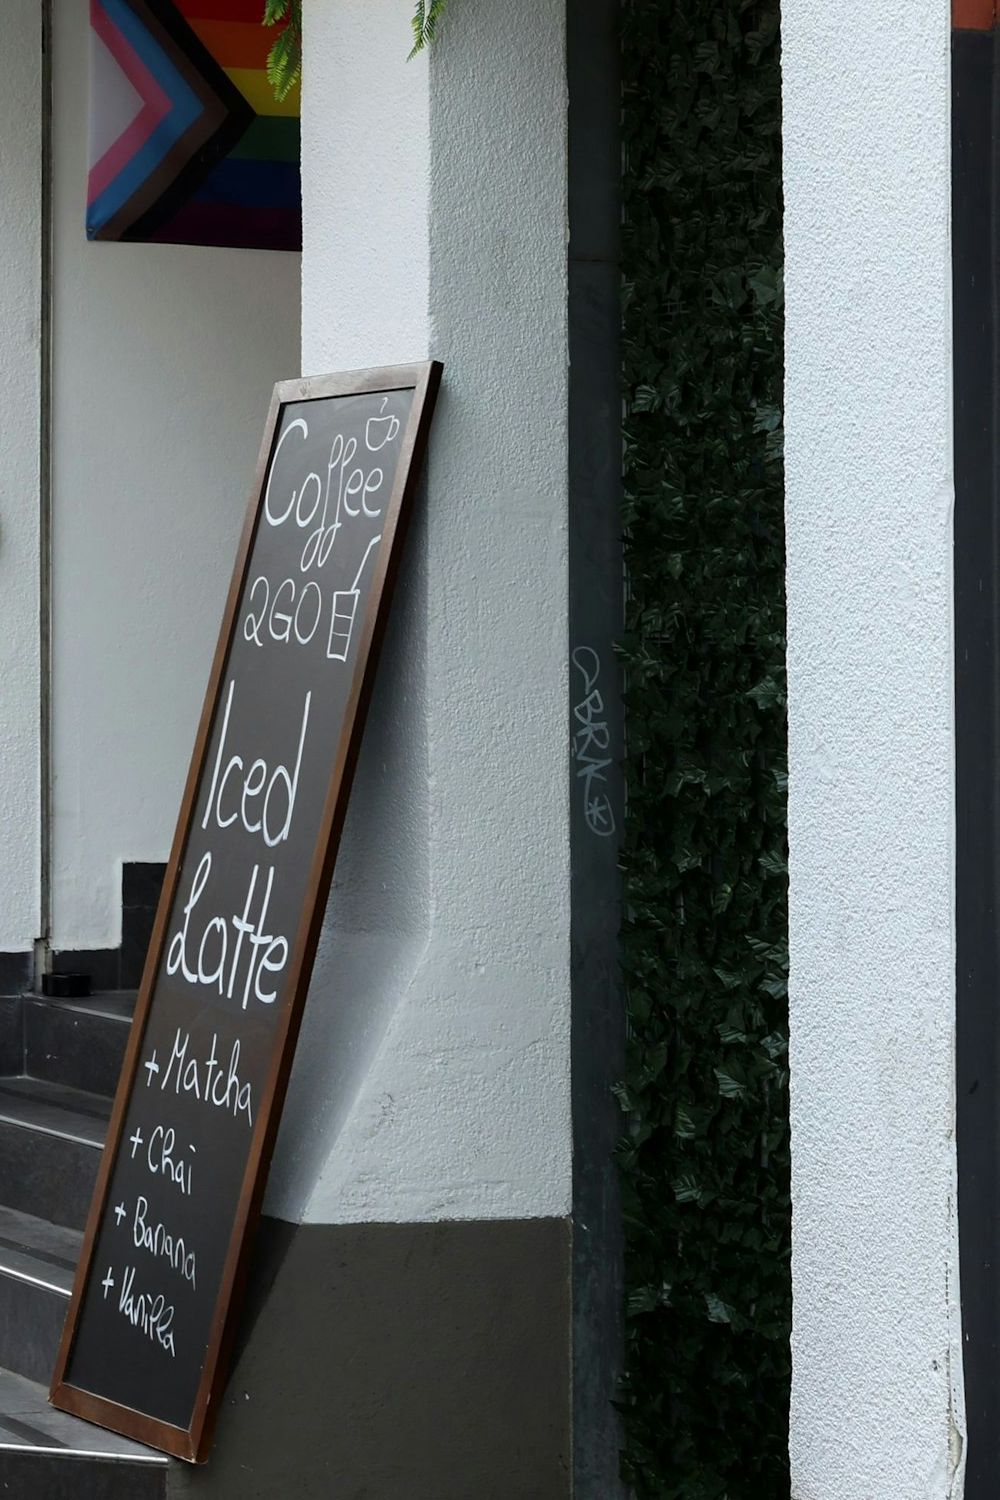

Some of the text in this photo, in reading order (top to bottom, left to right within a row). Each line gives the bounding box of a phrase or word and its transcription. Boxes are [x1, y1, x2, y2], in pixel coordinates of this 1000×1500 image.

[264, 417, 384, 573] Coffee
[243, 576, 322, 647] 2GO
[202, 679, 312, 847] Iced
[166, 851, 288, 1010] Latte
[161, 1028, 252, 1127] Matcha
[147, 1126, 196, 1195] Chai
[133, 1196, 196, 1290] Banana
